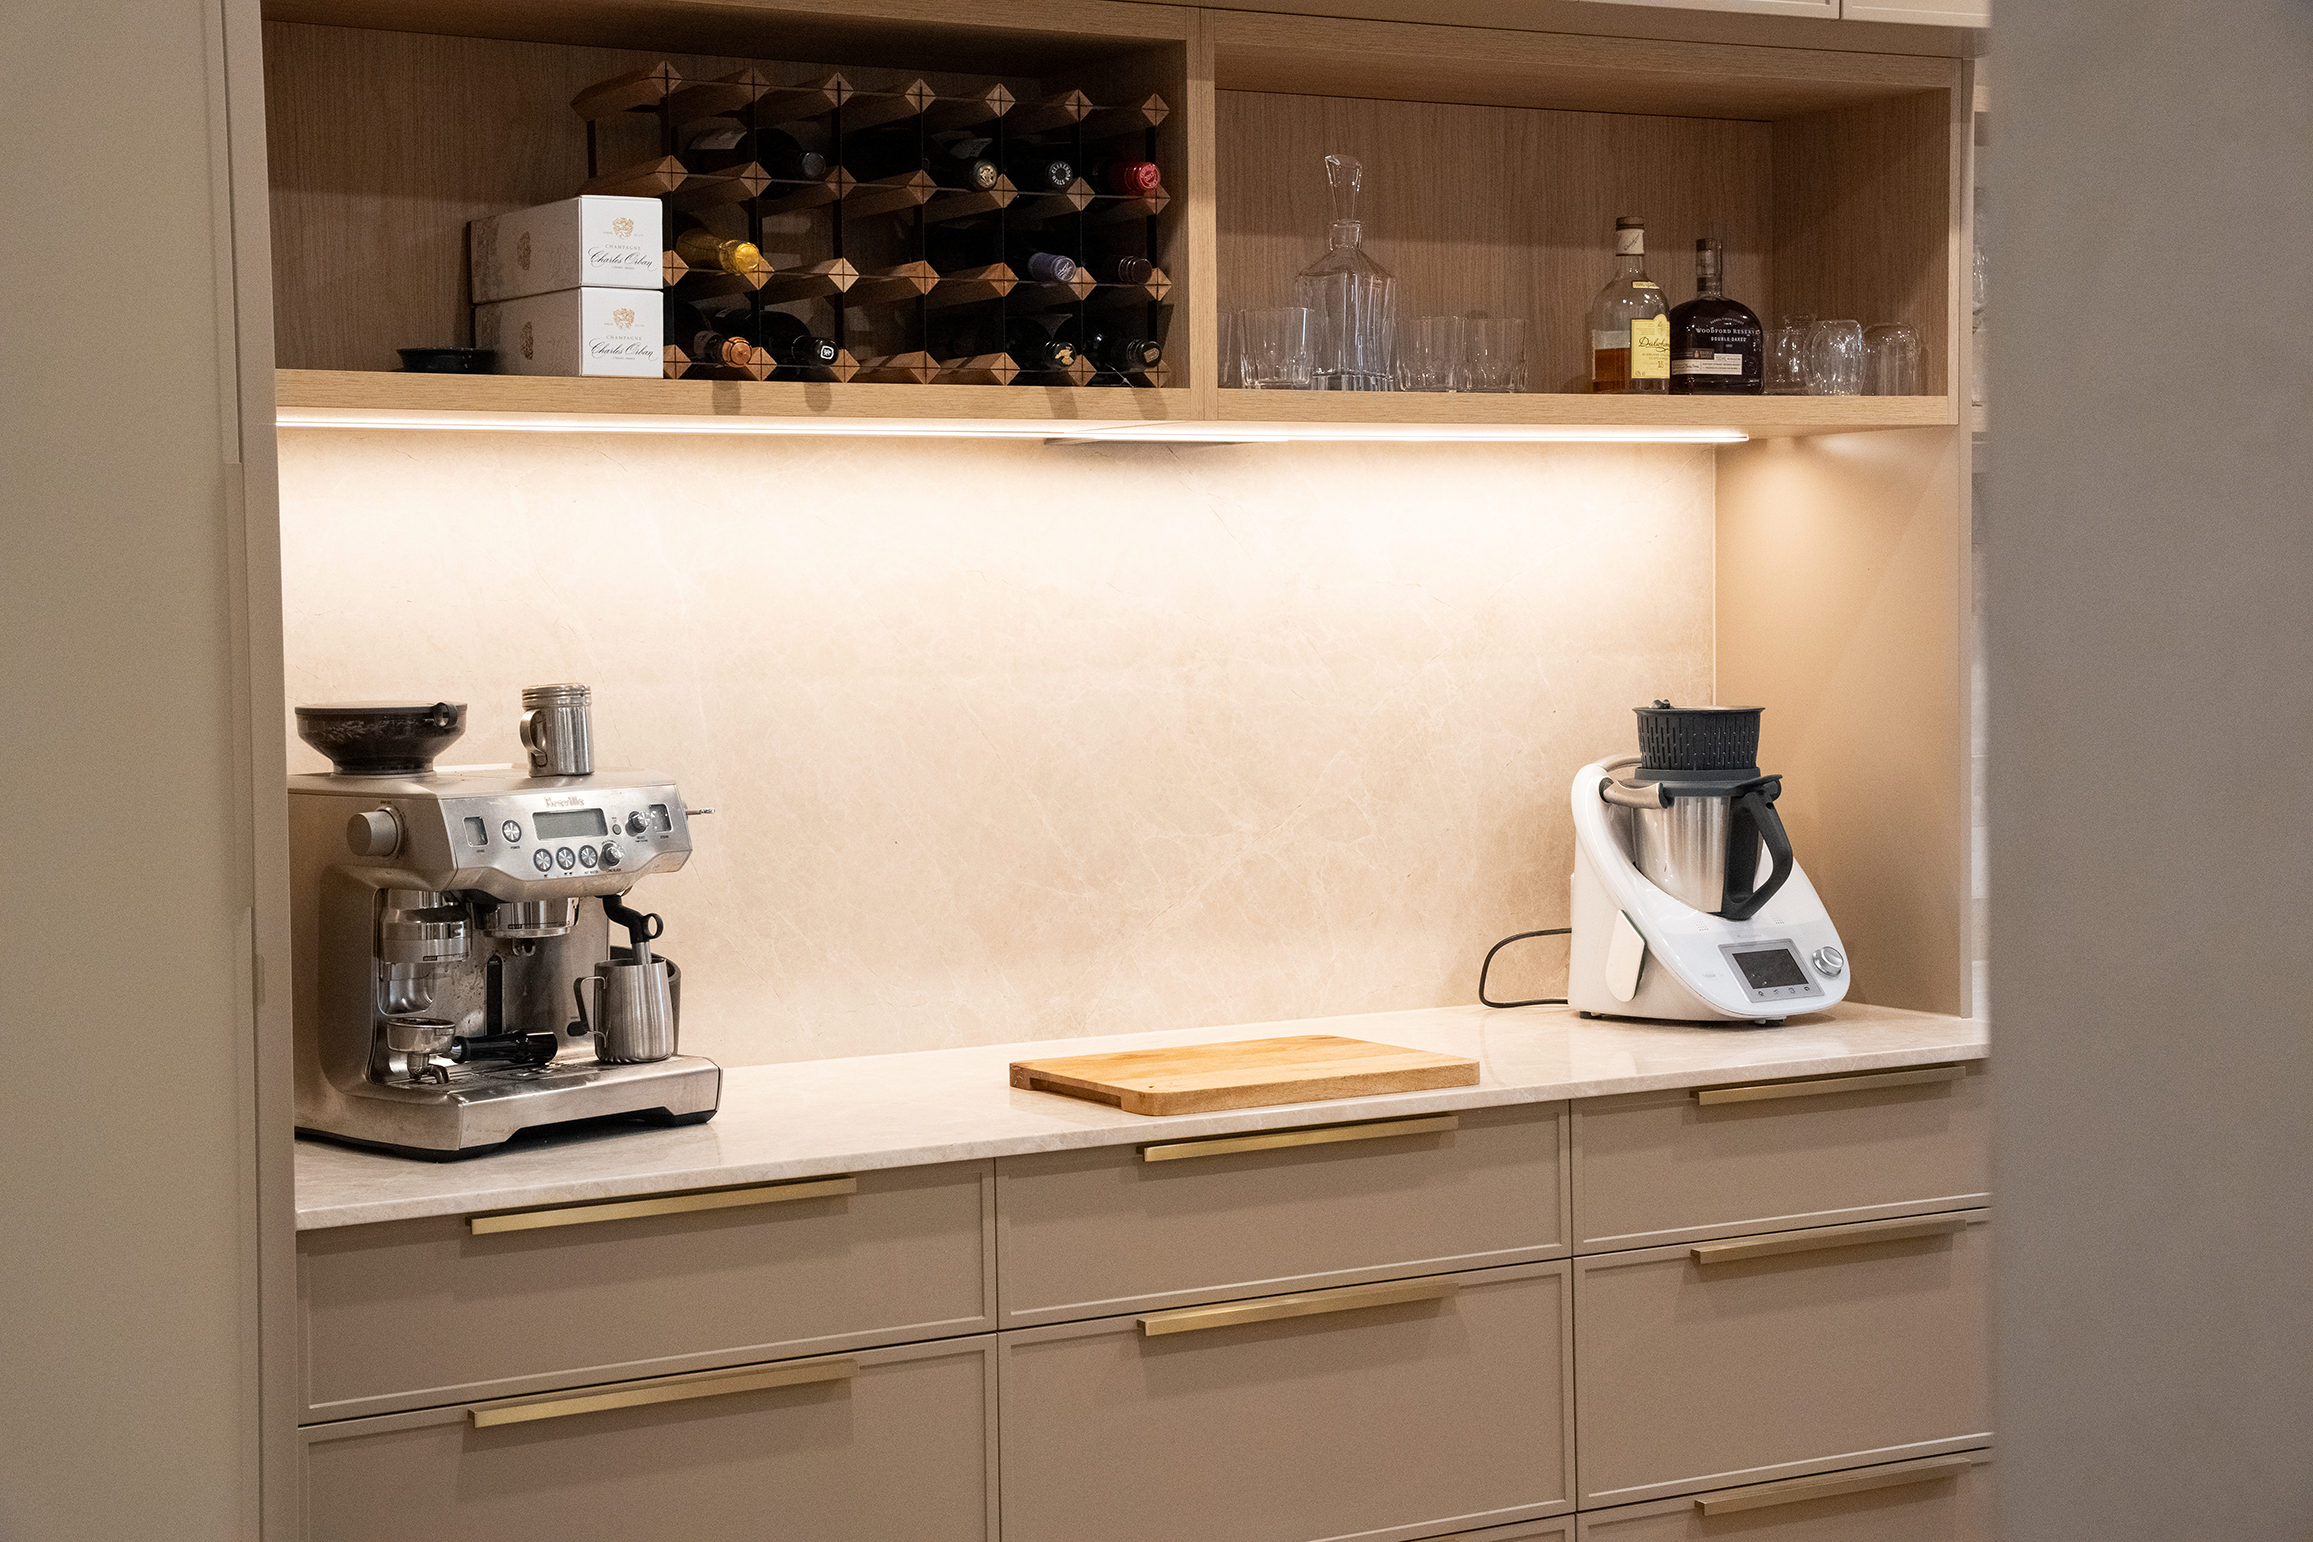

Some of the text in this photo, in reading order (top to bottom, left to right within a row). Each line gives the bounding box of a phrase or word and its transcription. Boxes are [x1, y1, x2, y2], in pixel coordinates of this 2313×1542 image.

[588, 247, 658, 272] Charles Orban
[588, 338, 659, 362] Charles Orban
[543, 796, 585, 808] Breville
